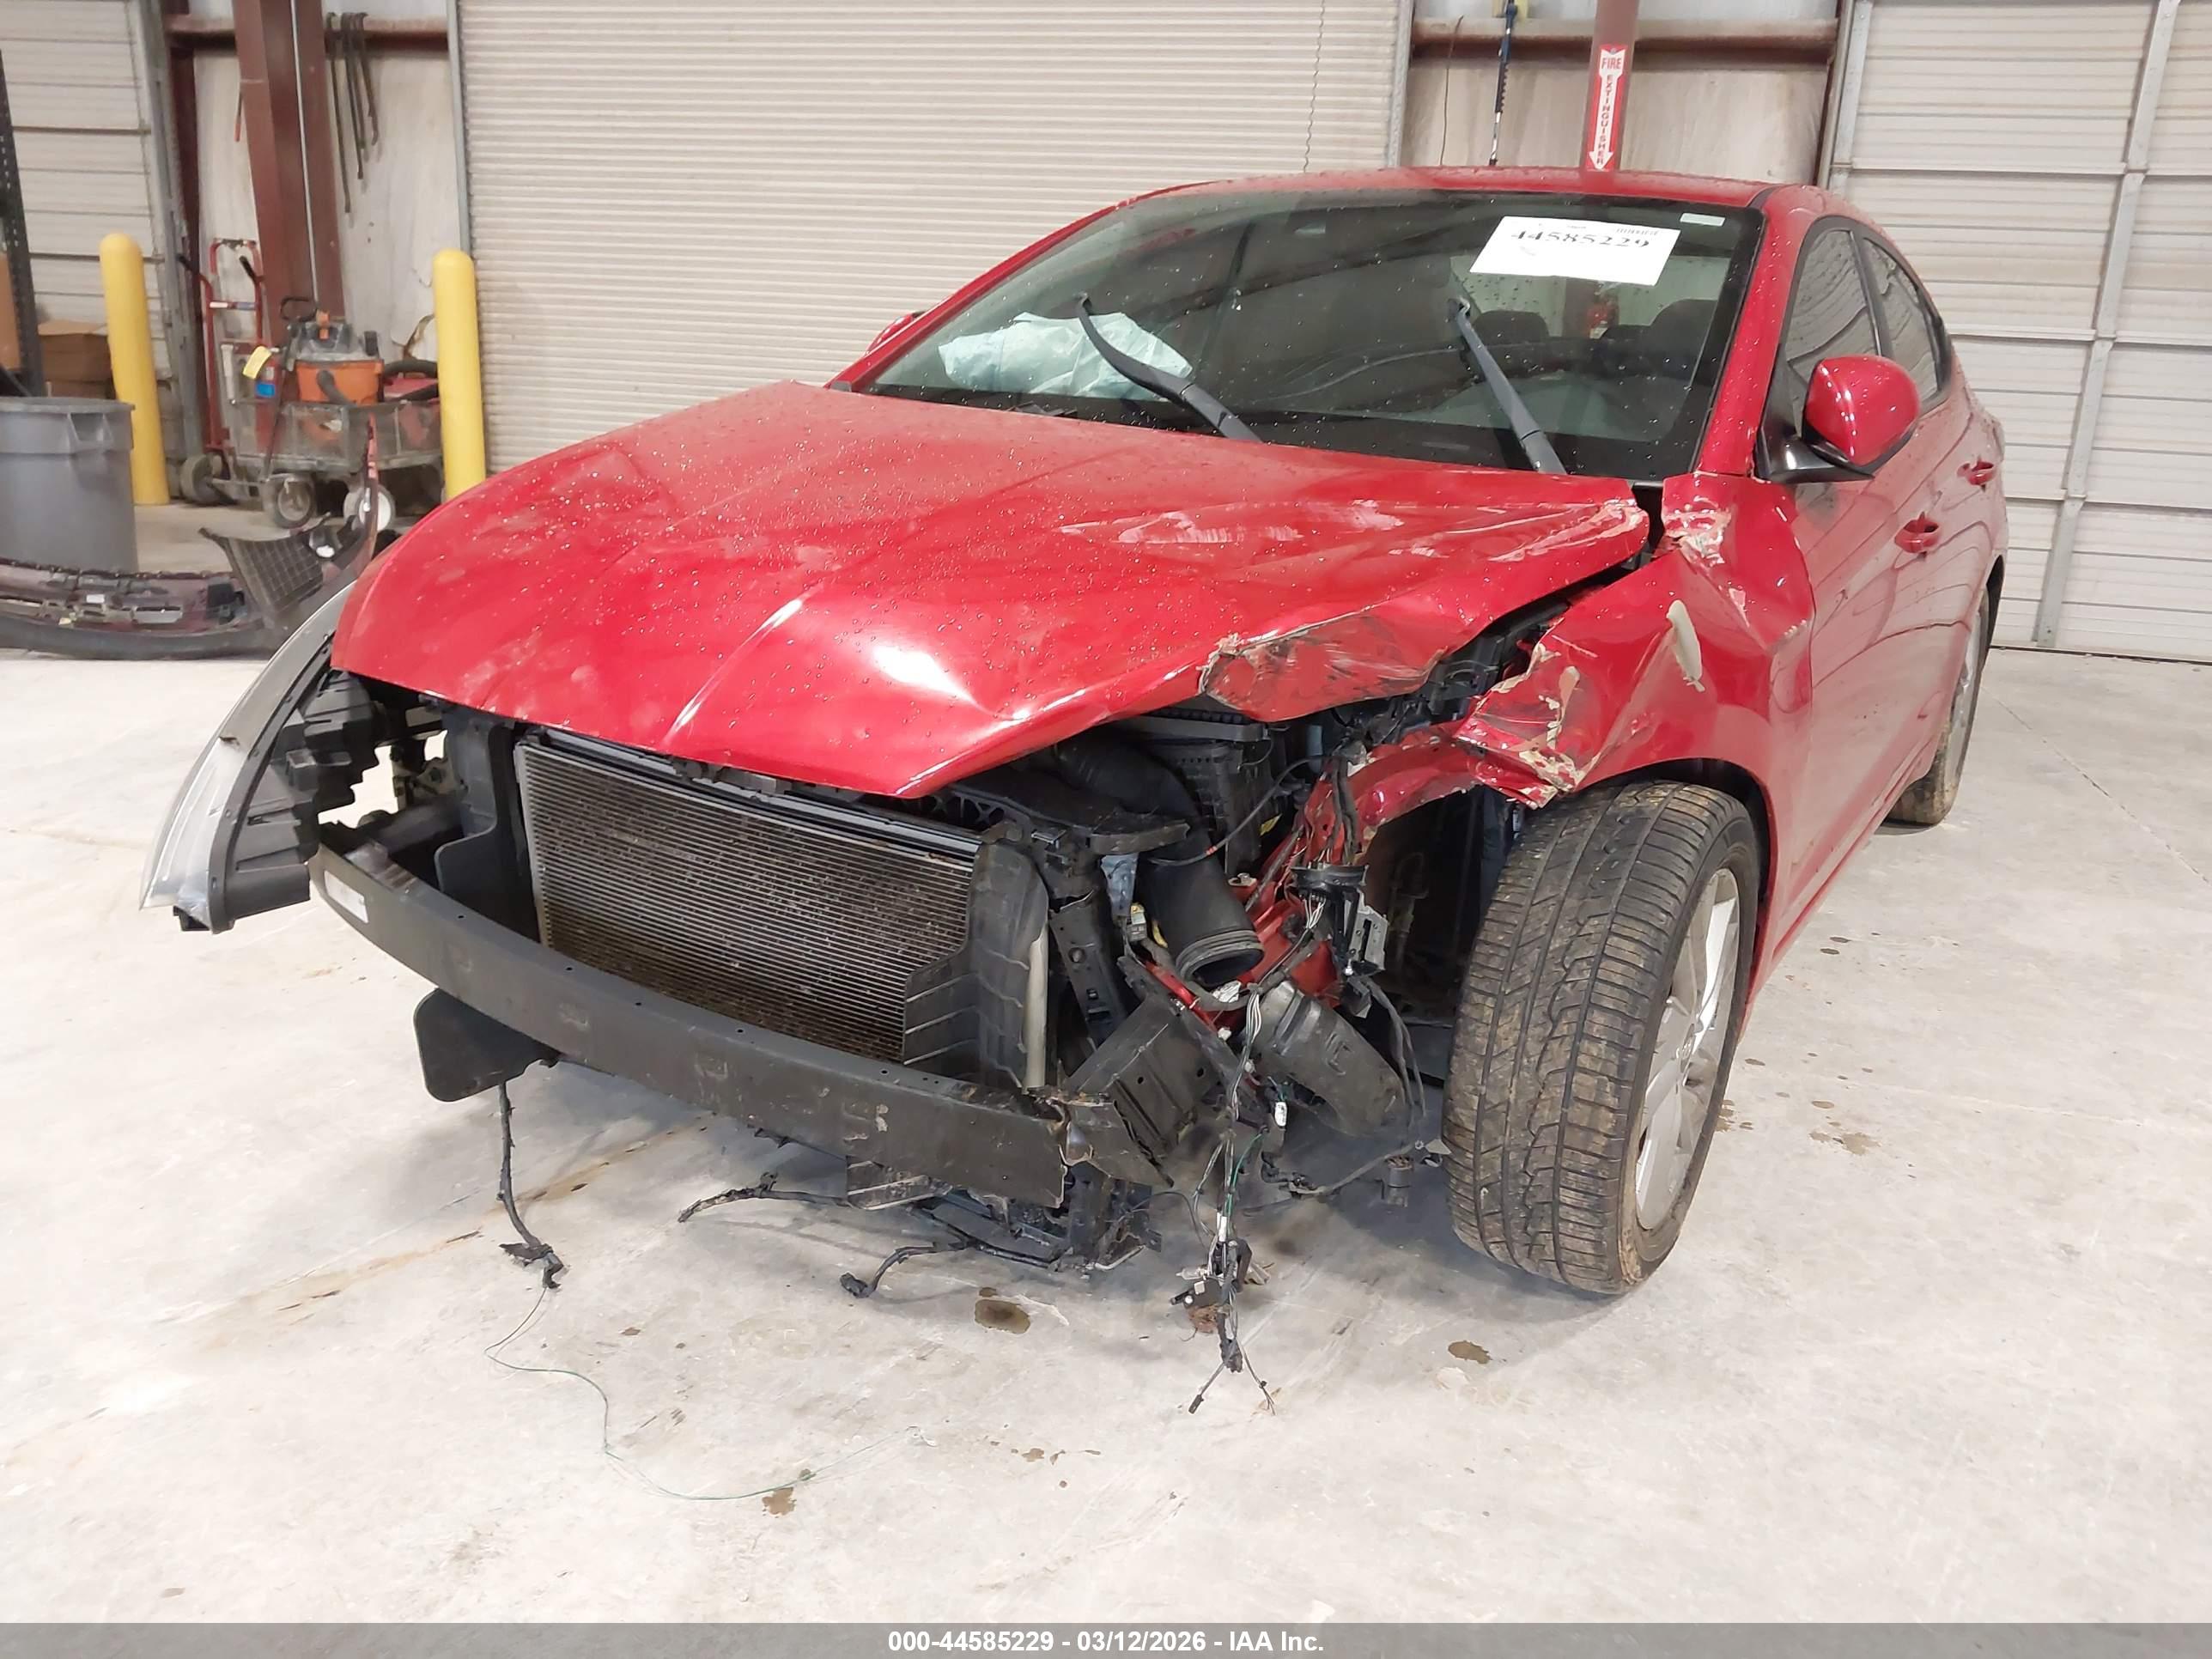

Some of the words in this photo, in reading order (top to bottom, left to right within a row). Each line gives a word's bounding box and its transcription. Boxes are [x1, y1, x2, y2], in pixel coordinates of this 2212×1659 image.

[1601, 57, 1622, 70] FIRE
[1596, 74, 1613, 166] EXTINGUISHER
[1511, 230, 1650, 247] 44585229
